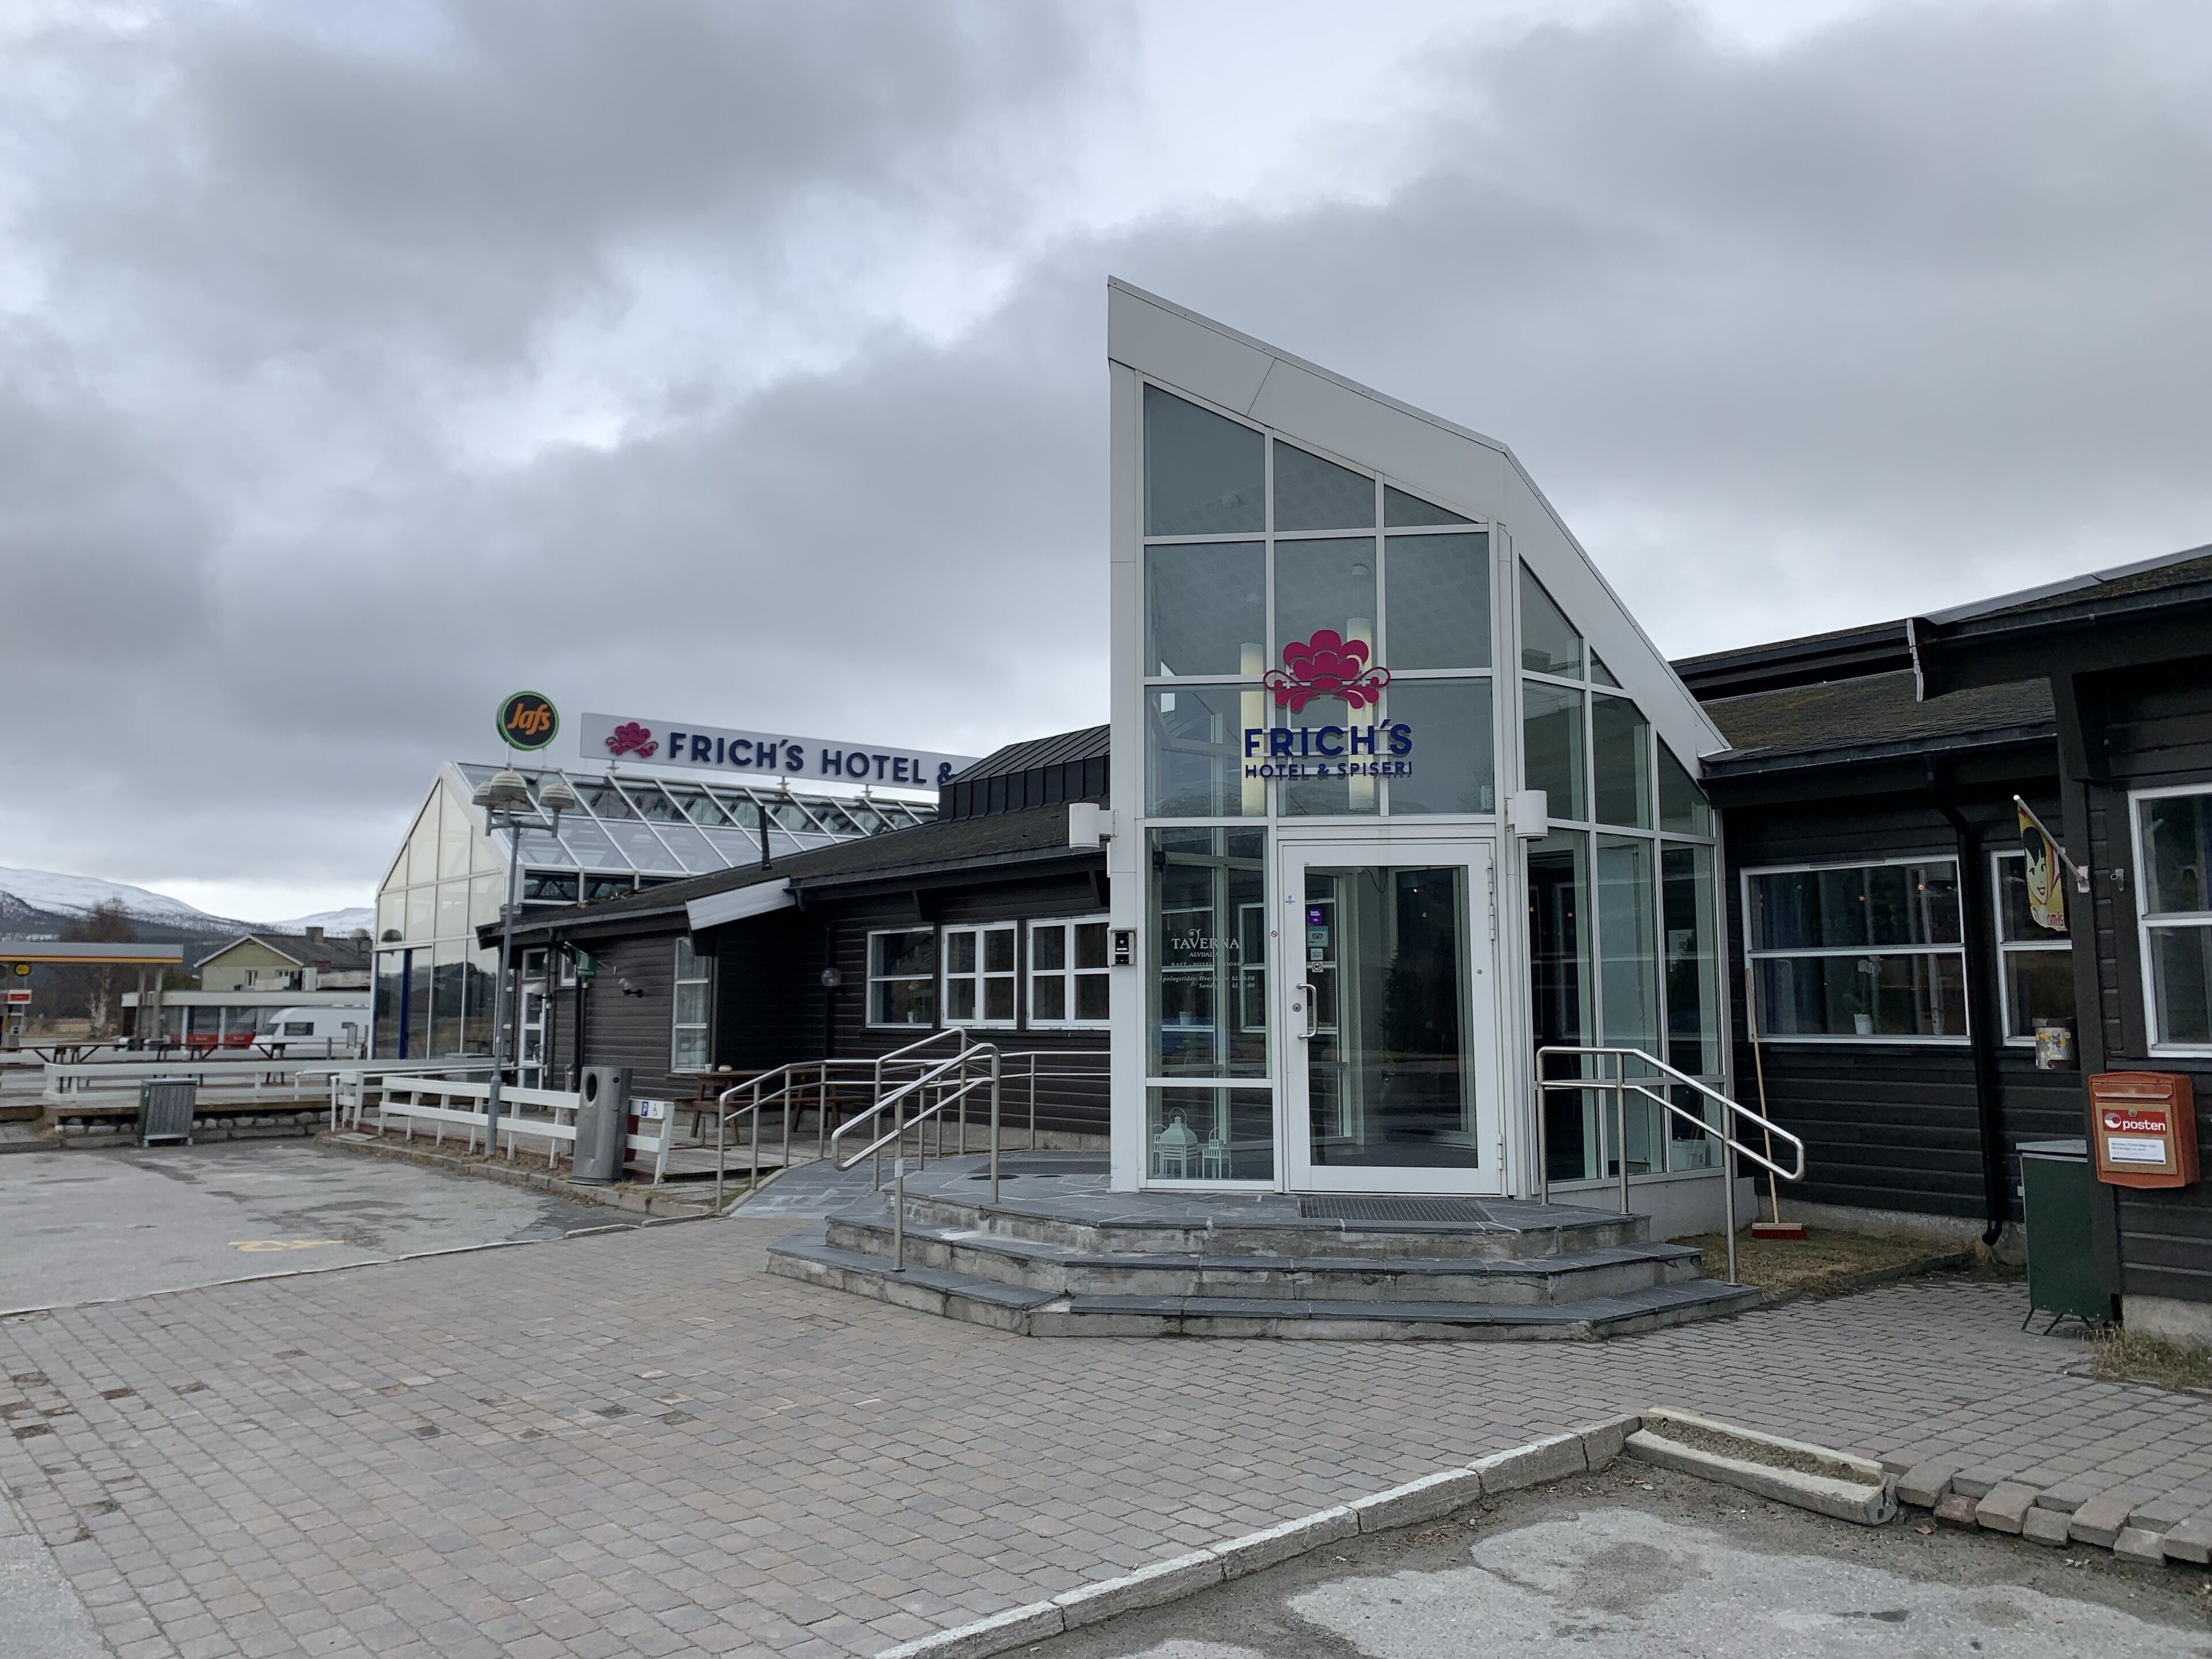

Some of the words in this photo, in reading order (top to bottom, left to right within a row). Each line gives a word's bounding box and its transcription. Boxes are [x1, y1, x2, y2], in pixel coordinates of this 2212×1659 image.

[507, 702, 550, 736] Jafs
[822, 749, 927, 784] HOTEL
[937, 762, 957, 786] &
[1245, 764, 1310, 778] HOTEL
[1317, 763, 1330, 777] &
[1337, 761, 1412, 777] SPISERI
[1171, 929, 1240, 949] TAVERNA
[642, 1103, 648, 1115] P
[2123, 1120, 2166, 1131] posten
